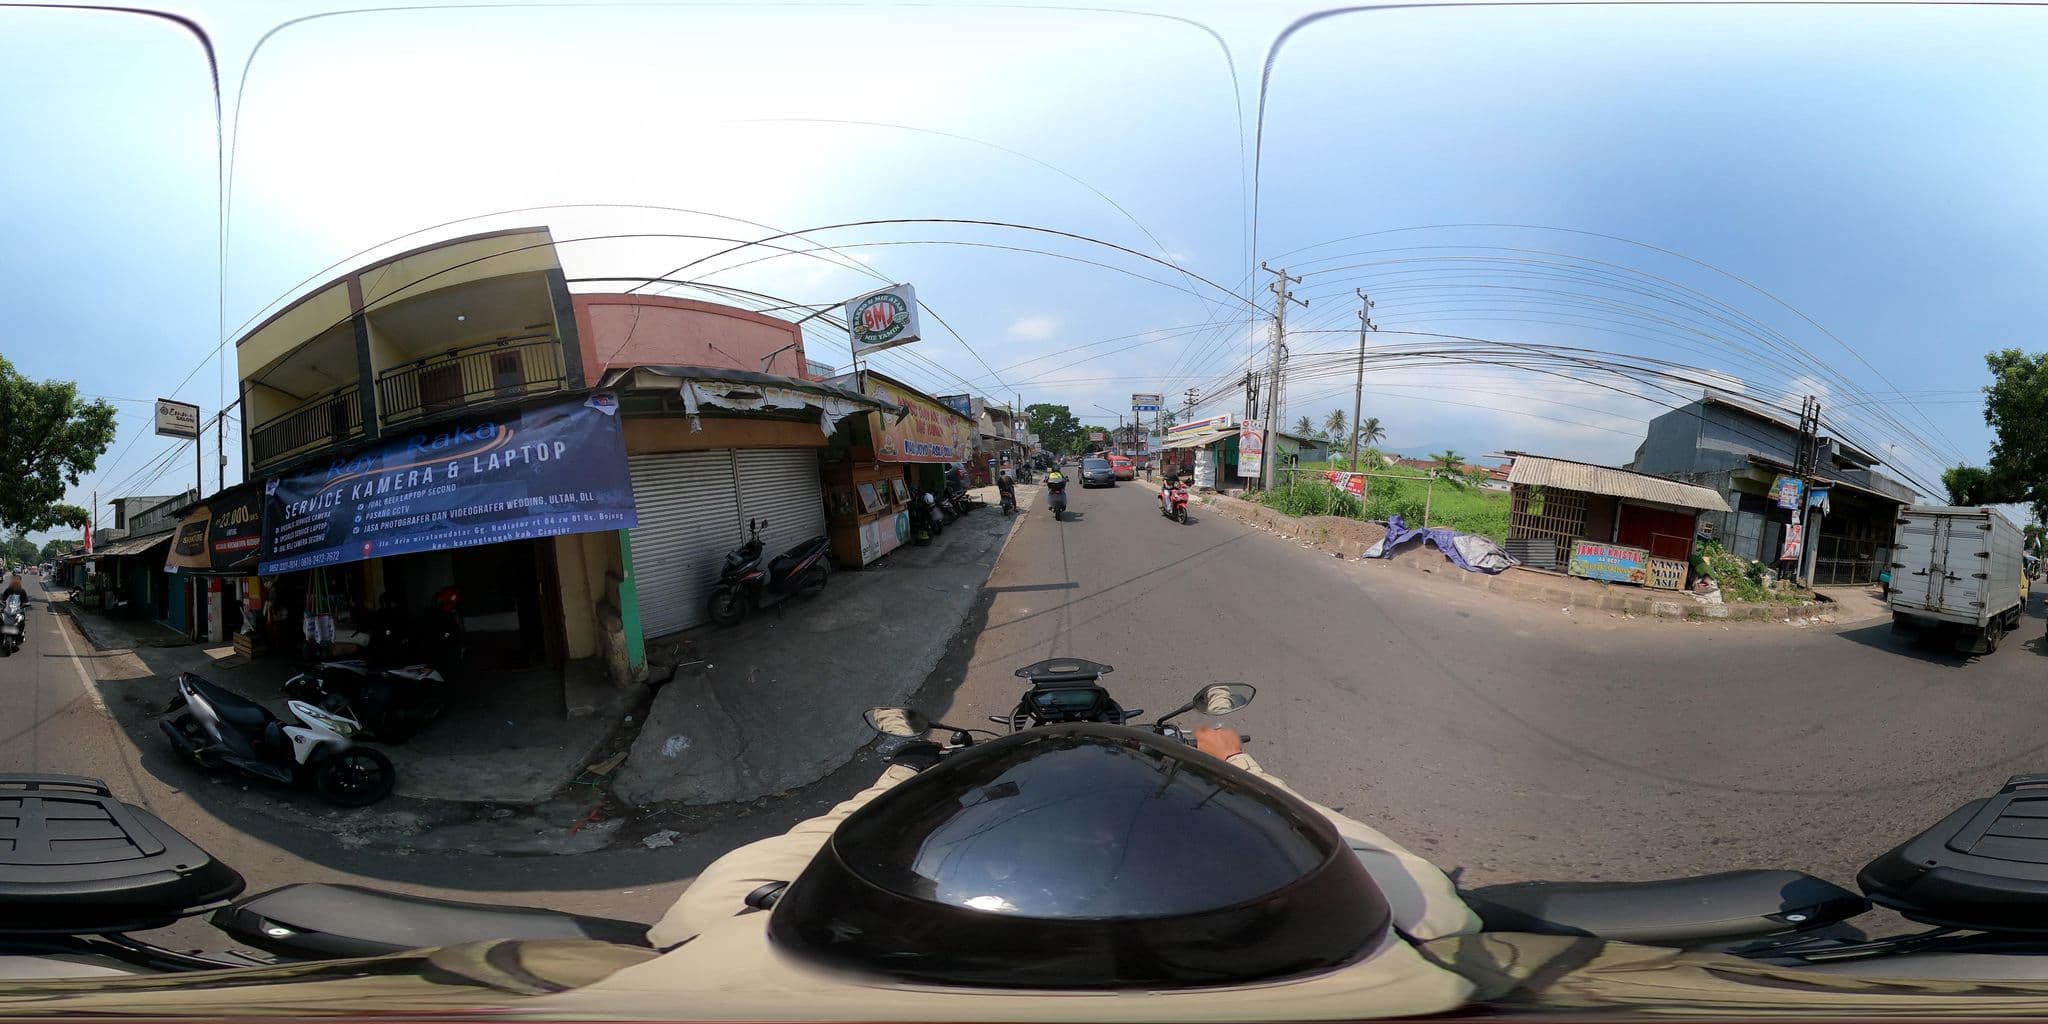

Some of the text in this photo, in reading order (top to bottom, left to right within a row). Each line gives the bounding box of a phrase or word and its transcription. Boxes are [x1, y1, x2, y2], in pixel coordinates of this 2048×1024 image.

[864, 302, 893, 329] BMJ
[407, 422, 498, 459] Raka
[285, 440, 566, 520] SERVICE KAMERA & LAPTOP
[400, 490, 426, 503] LAPTOP
[427, 483, 457, 496] SECOND
[363, 523, 379, 534] JASA
[380, 512, 431, 530] PHOTOGRAFER
[432, 509, 448, 523] DAN
[450, 502, 505, 519] VIDEOGRAFER
[580, 491, 595, 503] DLL
[365, 504, 411, 520] PASANG CCTV
[1651, 559, 1686, 571] NANAS
[1652, 568, 1683, 580] MADU
